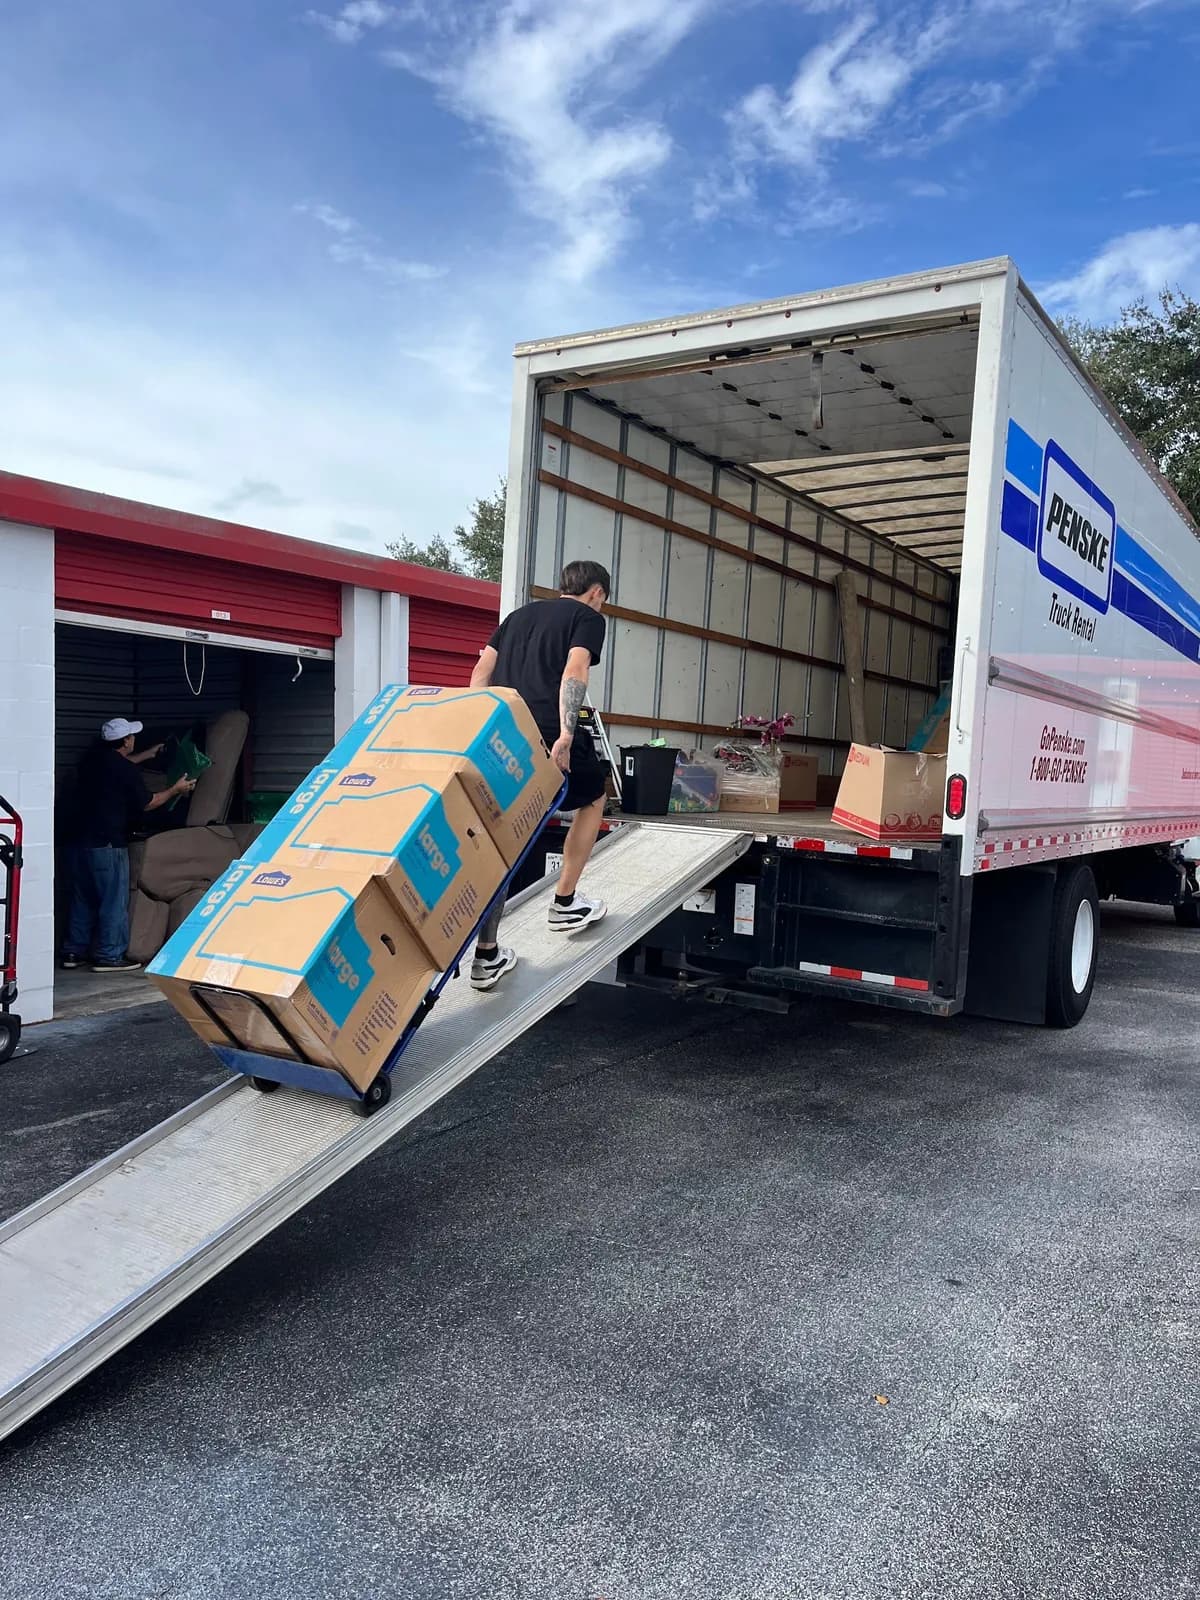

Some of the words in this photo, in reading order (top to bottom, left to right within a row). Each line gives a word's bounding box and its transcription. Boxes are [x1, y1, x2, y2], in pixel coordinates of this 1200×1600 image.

[1046, 492, 1109, 573] PENSKE
[1048, 592, 1071, 627] Truck
[1071, 610, 1097, 643] Rental
[363, 685, 407, 725] large
[489, 729, 525, 783] large
[1040, 724, 1085, 755] GoPenske.com
[289, 768, 339, 815] large
[343, 777, 373, 786] LOWE'S
[1029, 755, 1088, 784] 1-800-GO-PENSKE
[418, 823, 451, 878] large
[199, 864, 255, 918] large
[256, 874, 287, 886] LOWE'S
[328, 935, 360, 991] large
